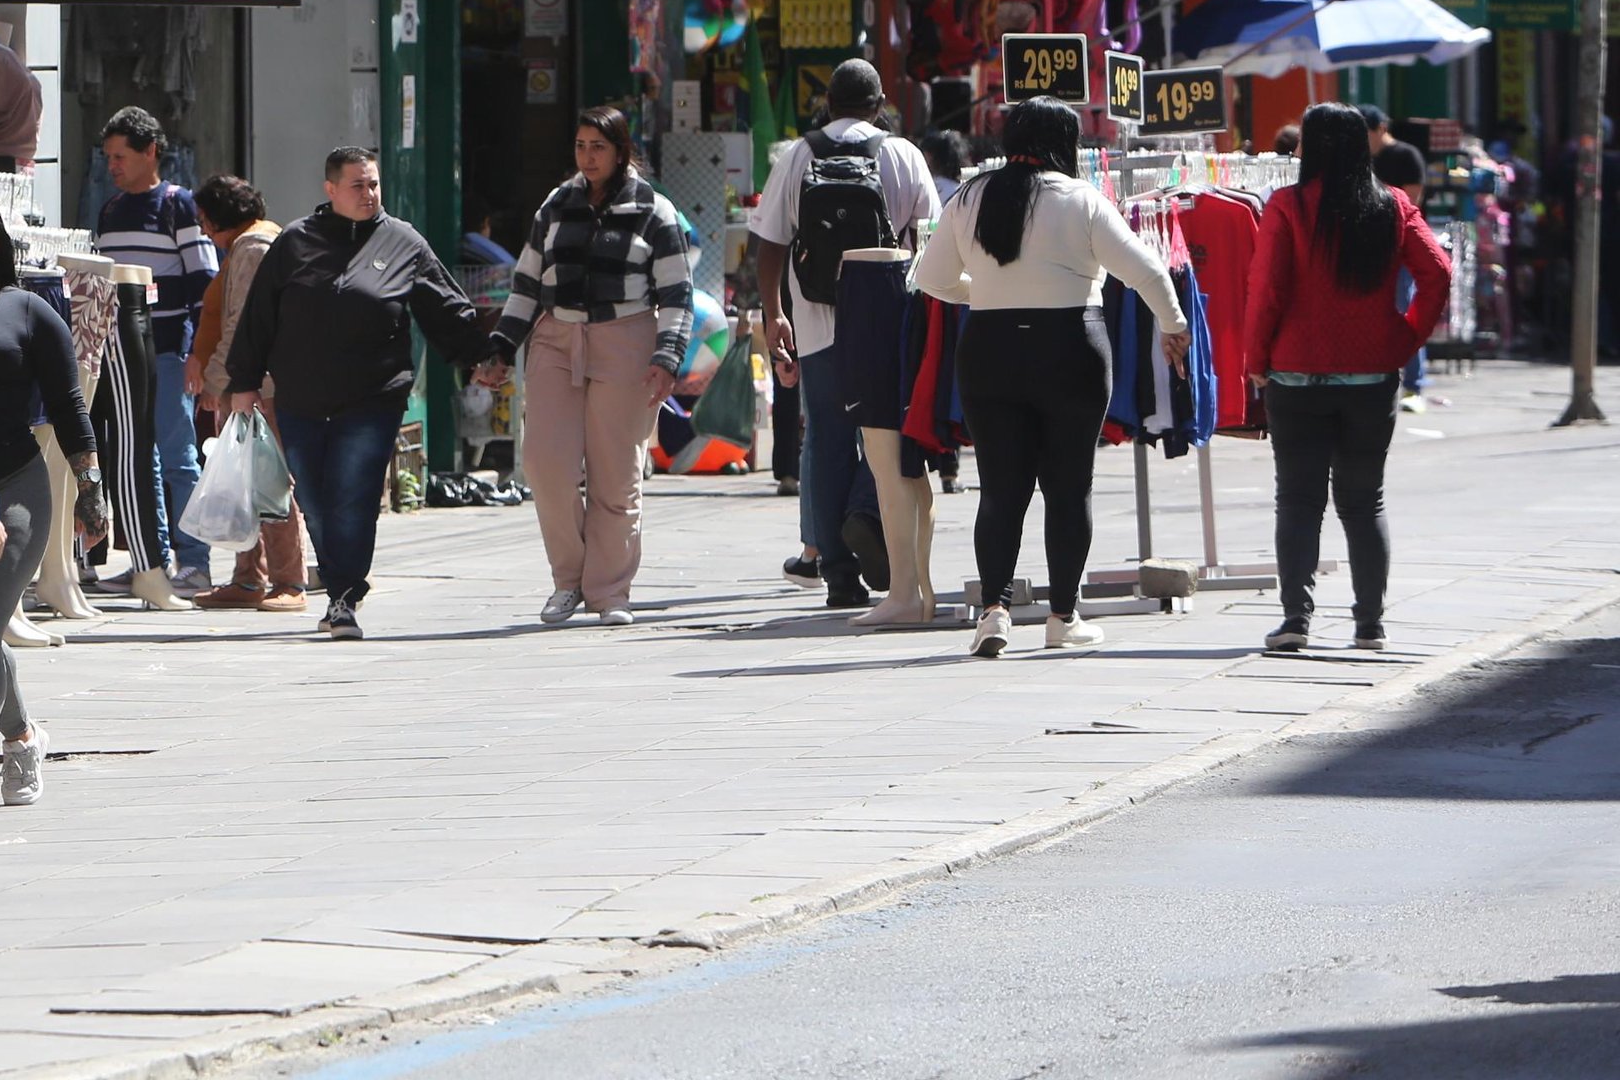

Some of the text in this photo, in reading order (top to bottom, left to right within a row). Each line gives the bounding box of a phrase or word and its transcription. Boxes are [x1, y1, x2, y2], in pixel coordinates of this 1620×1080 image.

[1023, 48, 1078, 91] 29,99
[1115, 65, 1138, 108] 19,99
[1156, 80, 1215, 122] 19,99
